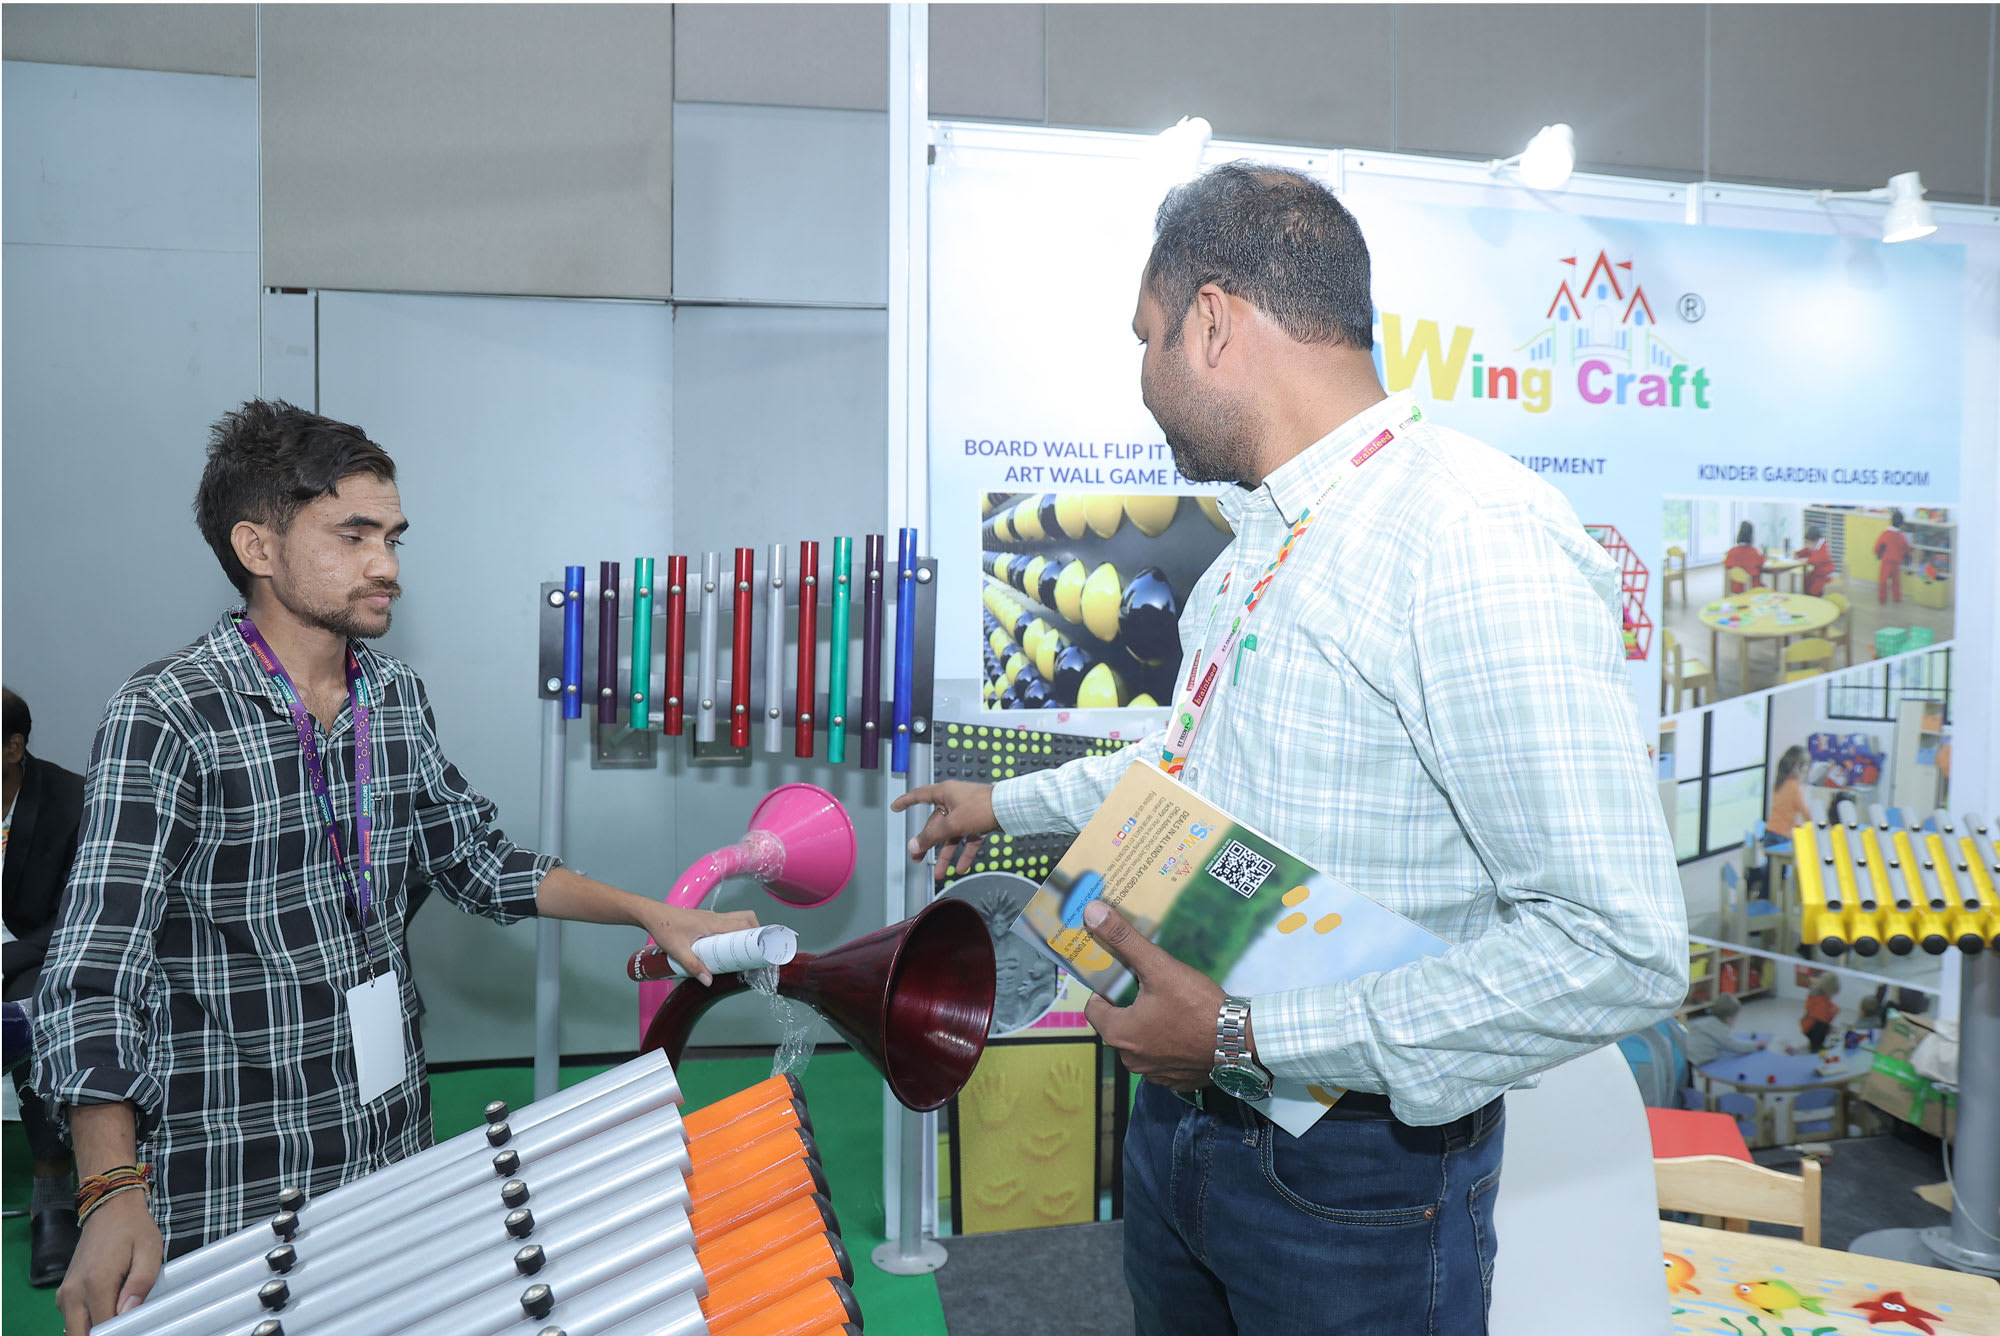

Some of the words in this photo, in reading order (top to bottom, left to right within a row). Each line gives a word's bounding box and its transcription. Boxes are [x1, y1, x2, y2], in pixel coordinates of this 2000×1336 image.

[1372, 306, 1552, 413] Wing
[1578, 359, 1711, 409] Craft
[964, 439, 1037, 456] BOARD
[1043, 441, 1099, 458] WALL
[1104, 443, 1143, 459] FLIP
[1150, 444, 1166, 460] IT
[1352, 431, 1393, 465] brainfeed
[1005, 466, 1044, 482] ART
[1050, 467, 1105, 484] WALL
[1109, 468, 1167, 485] GAME
[1699, 464, 1759, 481] KINDER
[1763, 466, 1829, 483] GARDEN
[1832, 468, 1879, 485] CLASS
[1882, 470, 1930, 486] ROOM
[273, 675, 291, 701] SKOLORS
[355, 678, 365, 703] SKOLORS
[1195, 665, 1217, 706] brainfeed
[1172, 809, 1189, 830] DEALS
[1159, 833, 1171, 846] ALL
[1167, 827, 1176, 836] IN
[1144, 856, 1153, 866] OF
[1149, 843, 1163, 859] KIND
[1134, 862, 1148, 878] PLAY
[1157, 854, 1177, 877] Craft
[1118, 875, 1138, 898] GROUND
